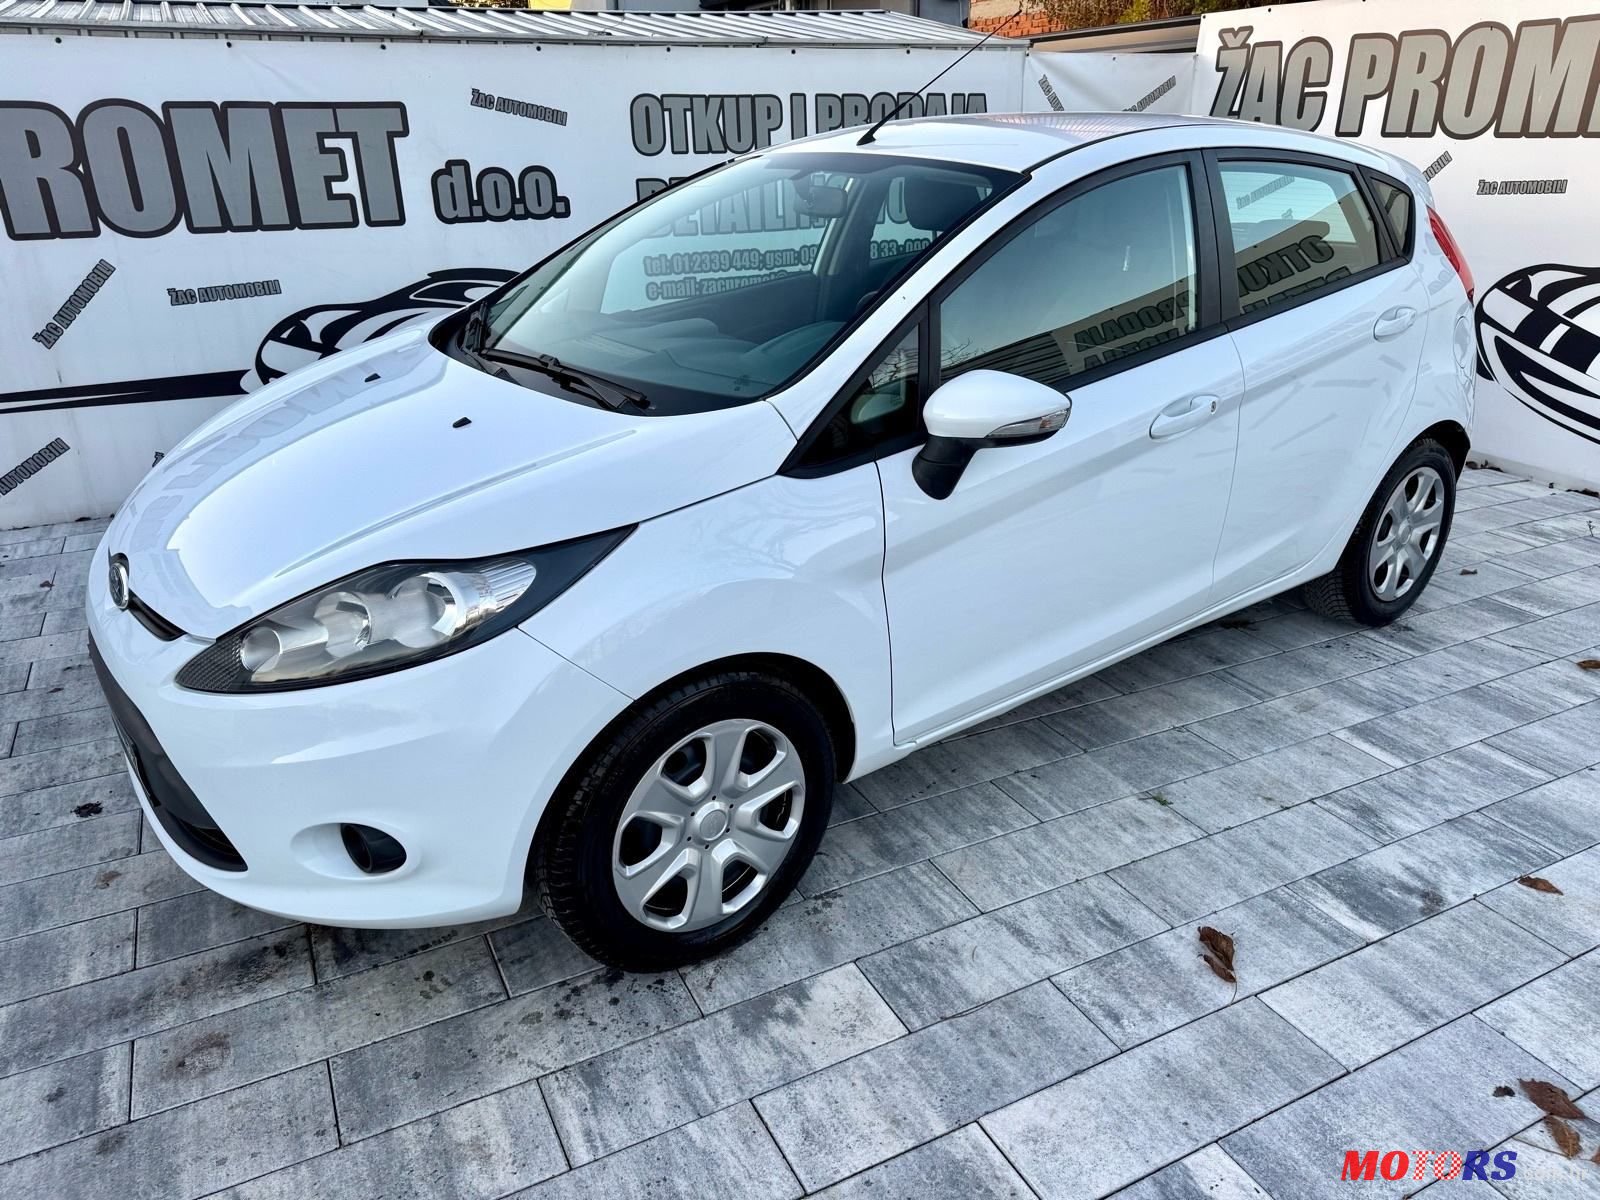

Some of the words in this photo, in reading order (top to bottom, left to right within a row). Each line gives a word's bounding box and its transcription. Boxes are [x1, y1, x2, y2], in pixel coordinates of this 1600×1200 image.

[1209, 25, 1334, 133] ŽAC
[1335, 14, 1600, 140] PROM
[470, 88, 495, 110] ŽAC
[495, 96, 568, 126] AUTOMOBILI
[630, 93, 784, 156] OTKUP
[790, 93, 807, 141] I
[0, 97, 409, 240] ROMET
[430, 159, 571, 225] d.o.o.
[1476, 179, 1498, 195] ŽAC
[1498, 179, 1568, 195] AUTOMOBILI
[643, 253, 672, 276] tel:
[763, 248, 799, 270] gsm:
[32, 322, 64, 350] ŽAC
[53, 258, 116, 329] AUTOMOBILI
[166, 288, 197, 306] ŽAC
[197, 279, 282, 303] AUTOMOBILI
[646, 277, 700, 300] e-mail:
[0, 437, 71, 496] AUTOMOBILI
